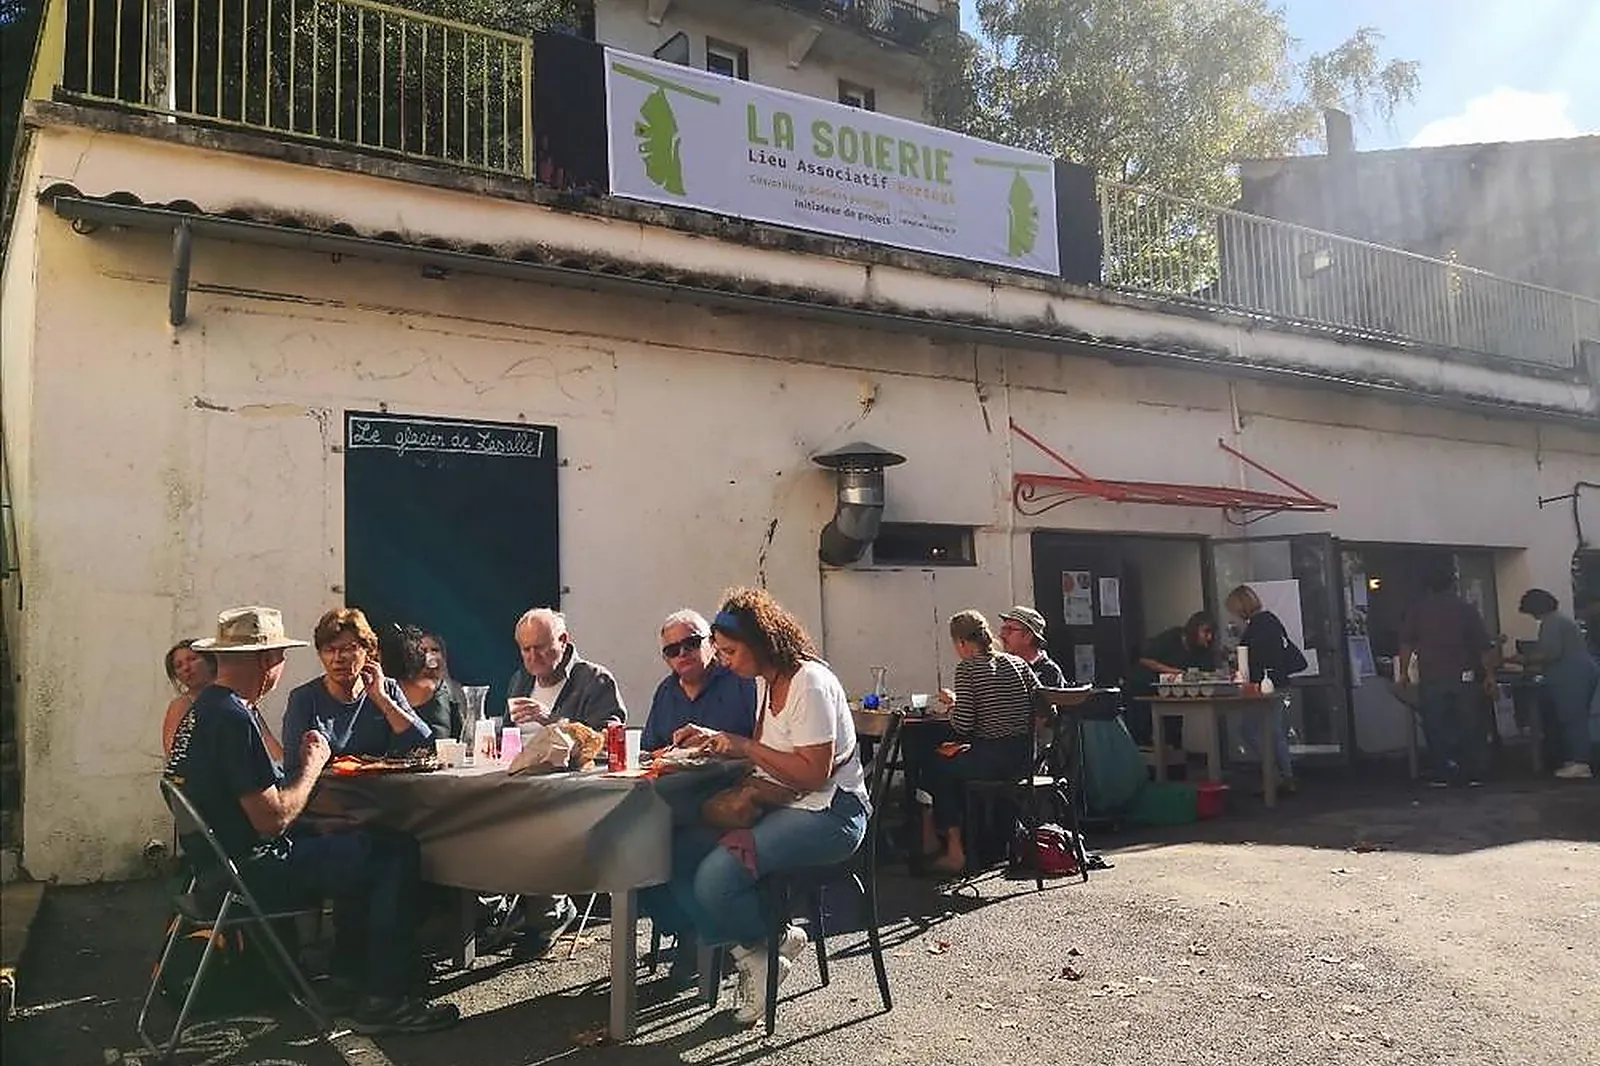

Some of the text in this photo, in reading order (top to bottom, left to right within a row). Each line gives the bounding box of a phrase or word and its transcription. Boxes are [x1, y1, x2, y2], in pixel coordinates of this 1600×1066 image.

[747, 103, 954, 185] LA SOIERIE
[748, 148, 787, 169] Lieu
[797, 159, 888, 189] Associatif
[353, 421, 381, 444] Le
